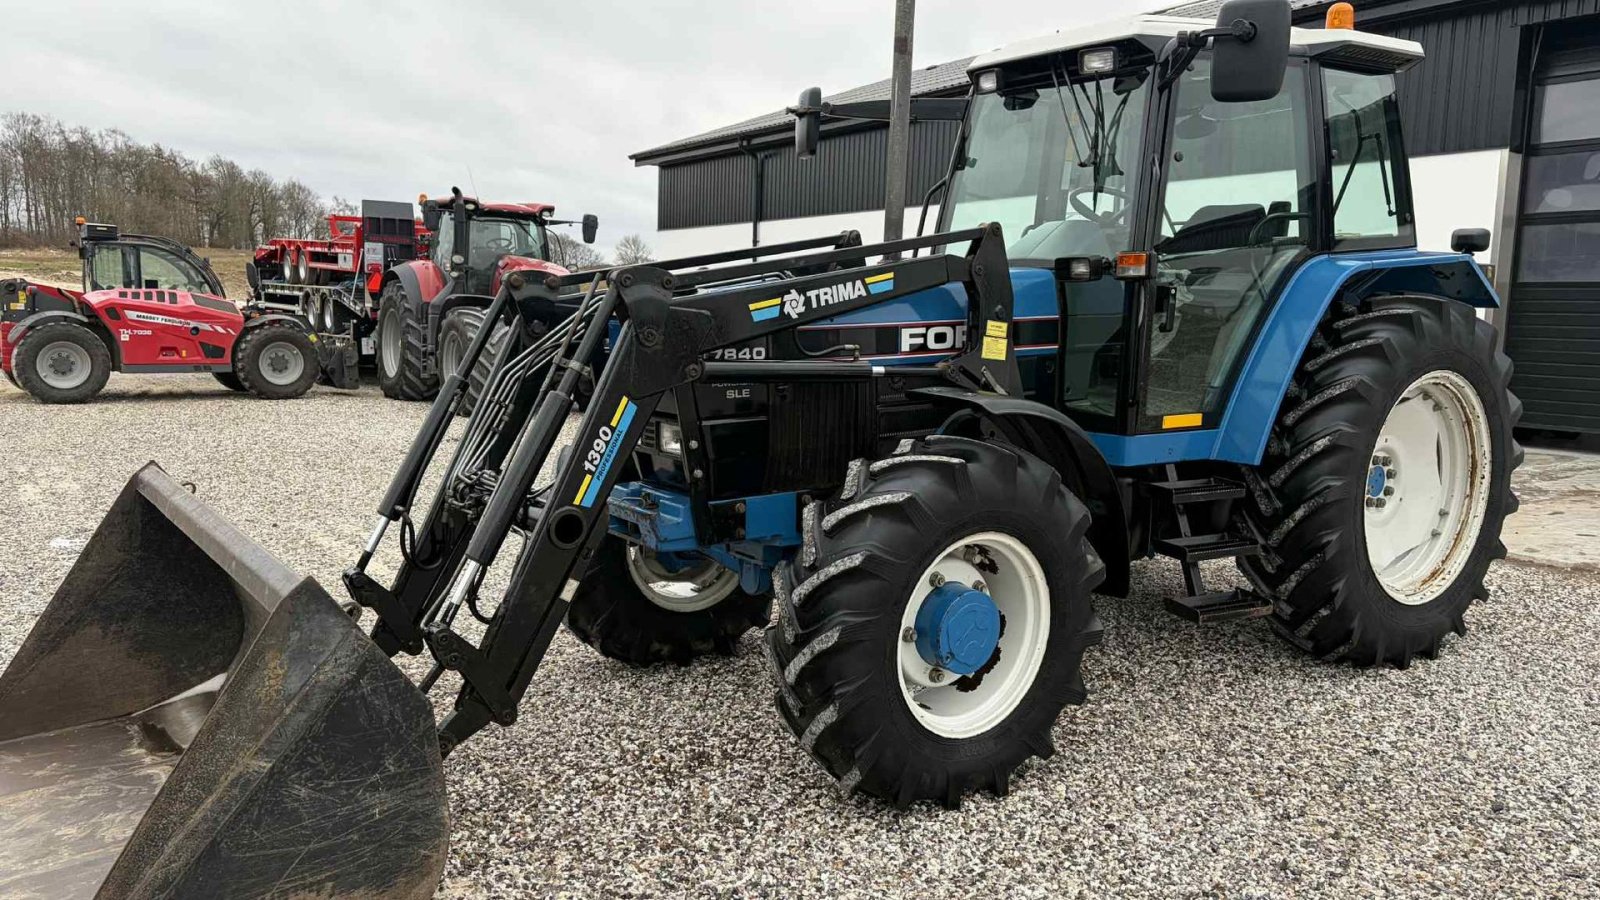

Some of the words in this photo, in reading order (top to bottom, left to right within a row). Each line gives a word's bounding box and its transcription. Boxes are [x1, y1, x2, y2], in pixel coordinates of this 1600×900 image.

[806, 279, 867, 309] TRIMA
[901, 325, 967, 352] FO
[709, 346, 766, 360] 7840
[726, 388, 751, 399] SLE
[584, 426, 612, 472] 1390
[596, 429, 623, 481] PROFESSIONAL
